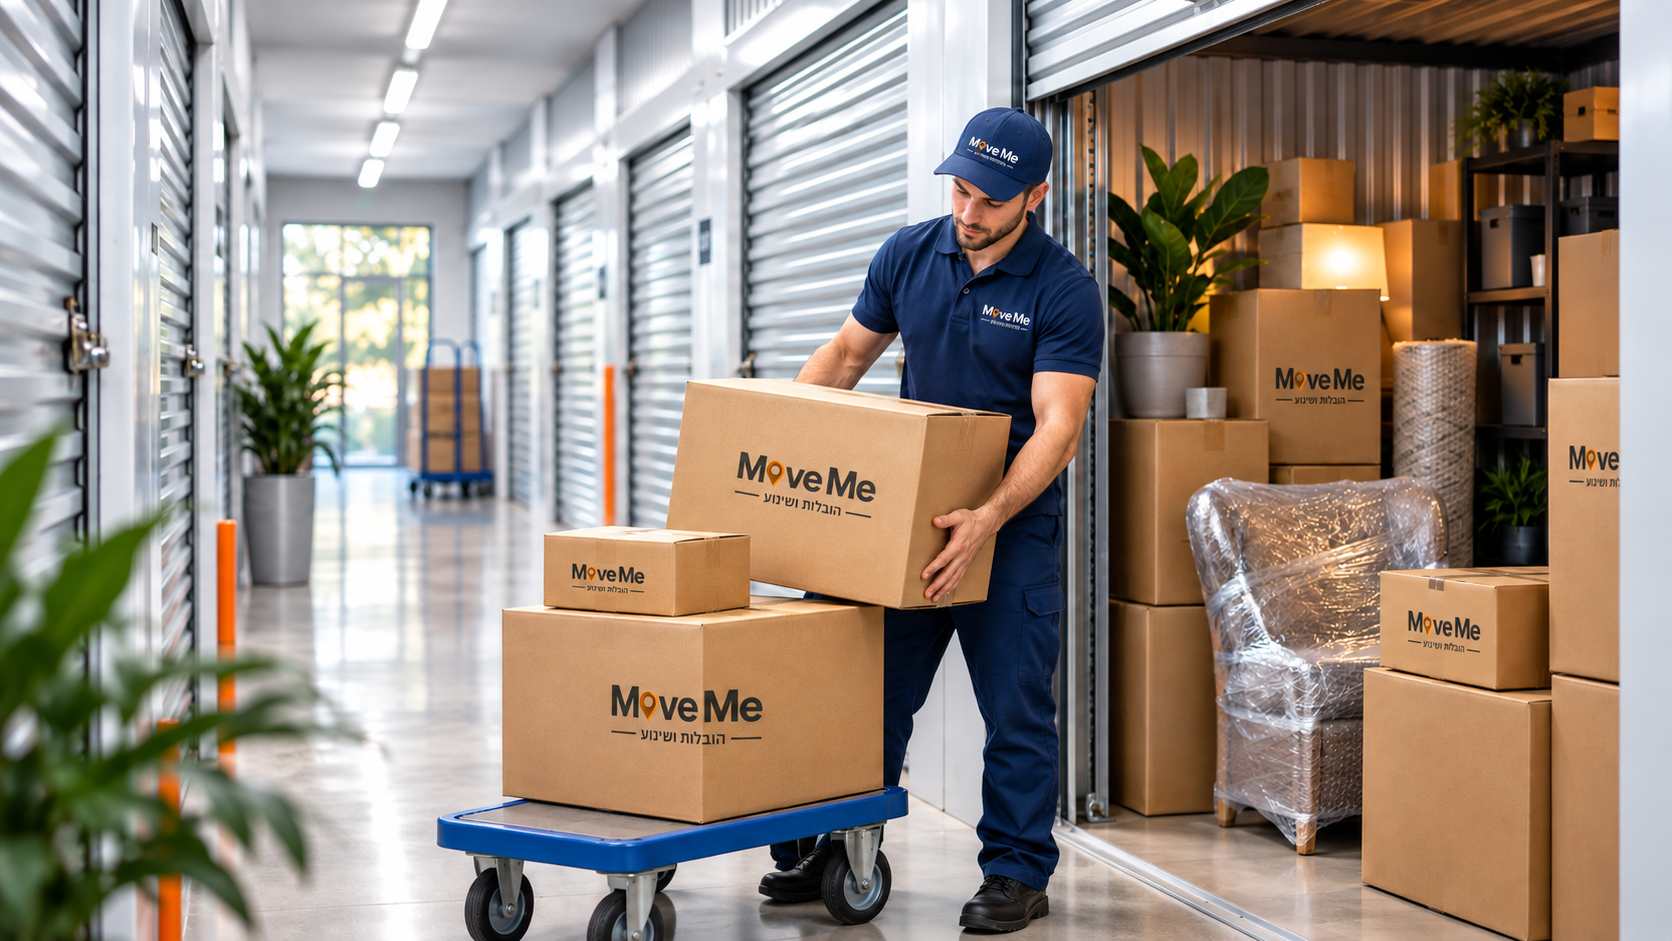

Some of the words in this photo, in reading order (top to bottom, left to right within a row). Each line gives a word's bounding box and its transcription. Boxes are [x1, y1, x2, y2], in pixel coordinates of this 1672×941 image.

[968, 136, 1000, 156] Move
[1000, 147, 1019, 164] Me
[982, 304, 1012, 321] Move
[1012, 312, 1031, 326] Me
[1275, 367, 1331, 390] Move
[1333, 368, 1365, 391] Me
[1569, 445, 1620, 471] Move
[737, 451, 823, 493] Move
[825, 466, 876, 503] Me
[763, 493, 799, 508] ושינוע
[801, 499, 842, 516] הובלות
[572, 563, 617, 582] Move
[618, 566, 645, 584] Me
[1408, 610, 1453, 637] Move
[1454, 616, 1481, 641] Me
[611, 684, 699, 722] Move
[703, 689, 763, 723] Me
[640, 729, 677, 743] ושינוע
[680, 732, 726, 745] הובלות
